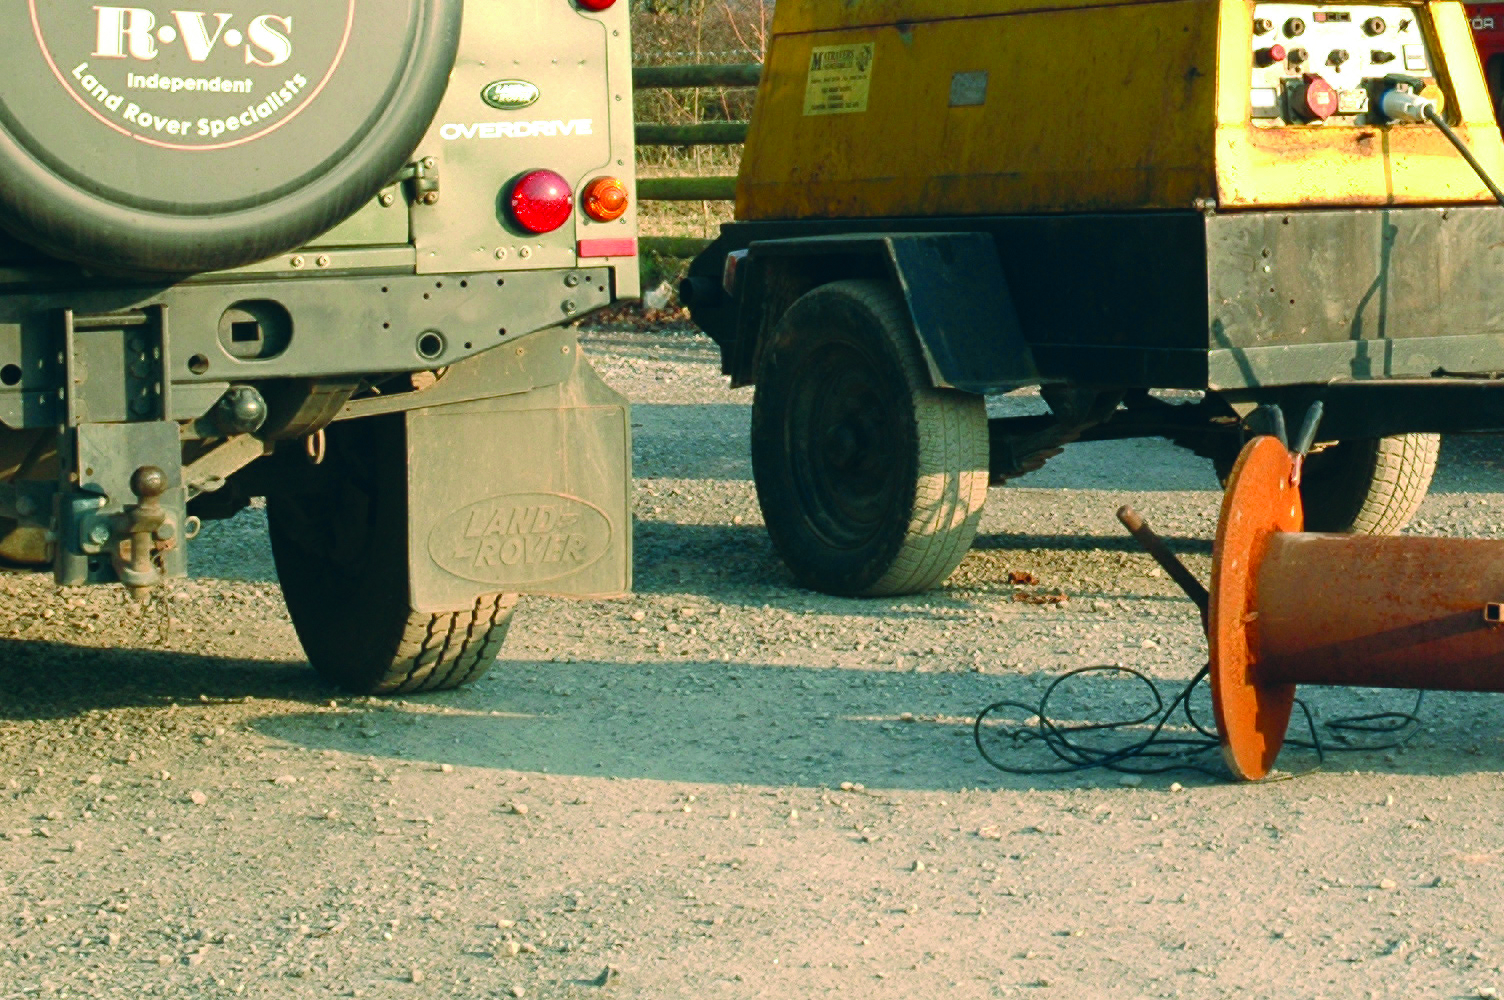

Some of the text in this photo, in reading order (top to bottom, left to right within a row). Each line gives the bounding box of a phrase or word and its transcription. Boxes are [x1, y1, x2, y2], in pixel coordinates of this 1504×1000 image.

[71, 62, 308, 138] Land Rover Specialists
[127, 72, 254, 93] Independent
[439, 118, 593, 141] OVERDRIVE
[463, 504, 558, 539] LAND
[472, 533, 586, 568] ROVER
